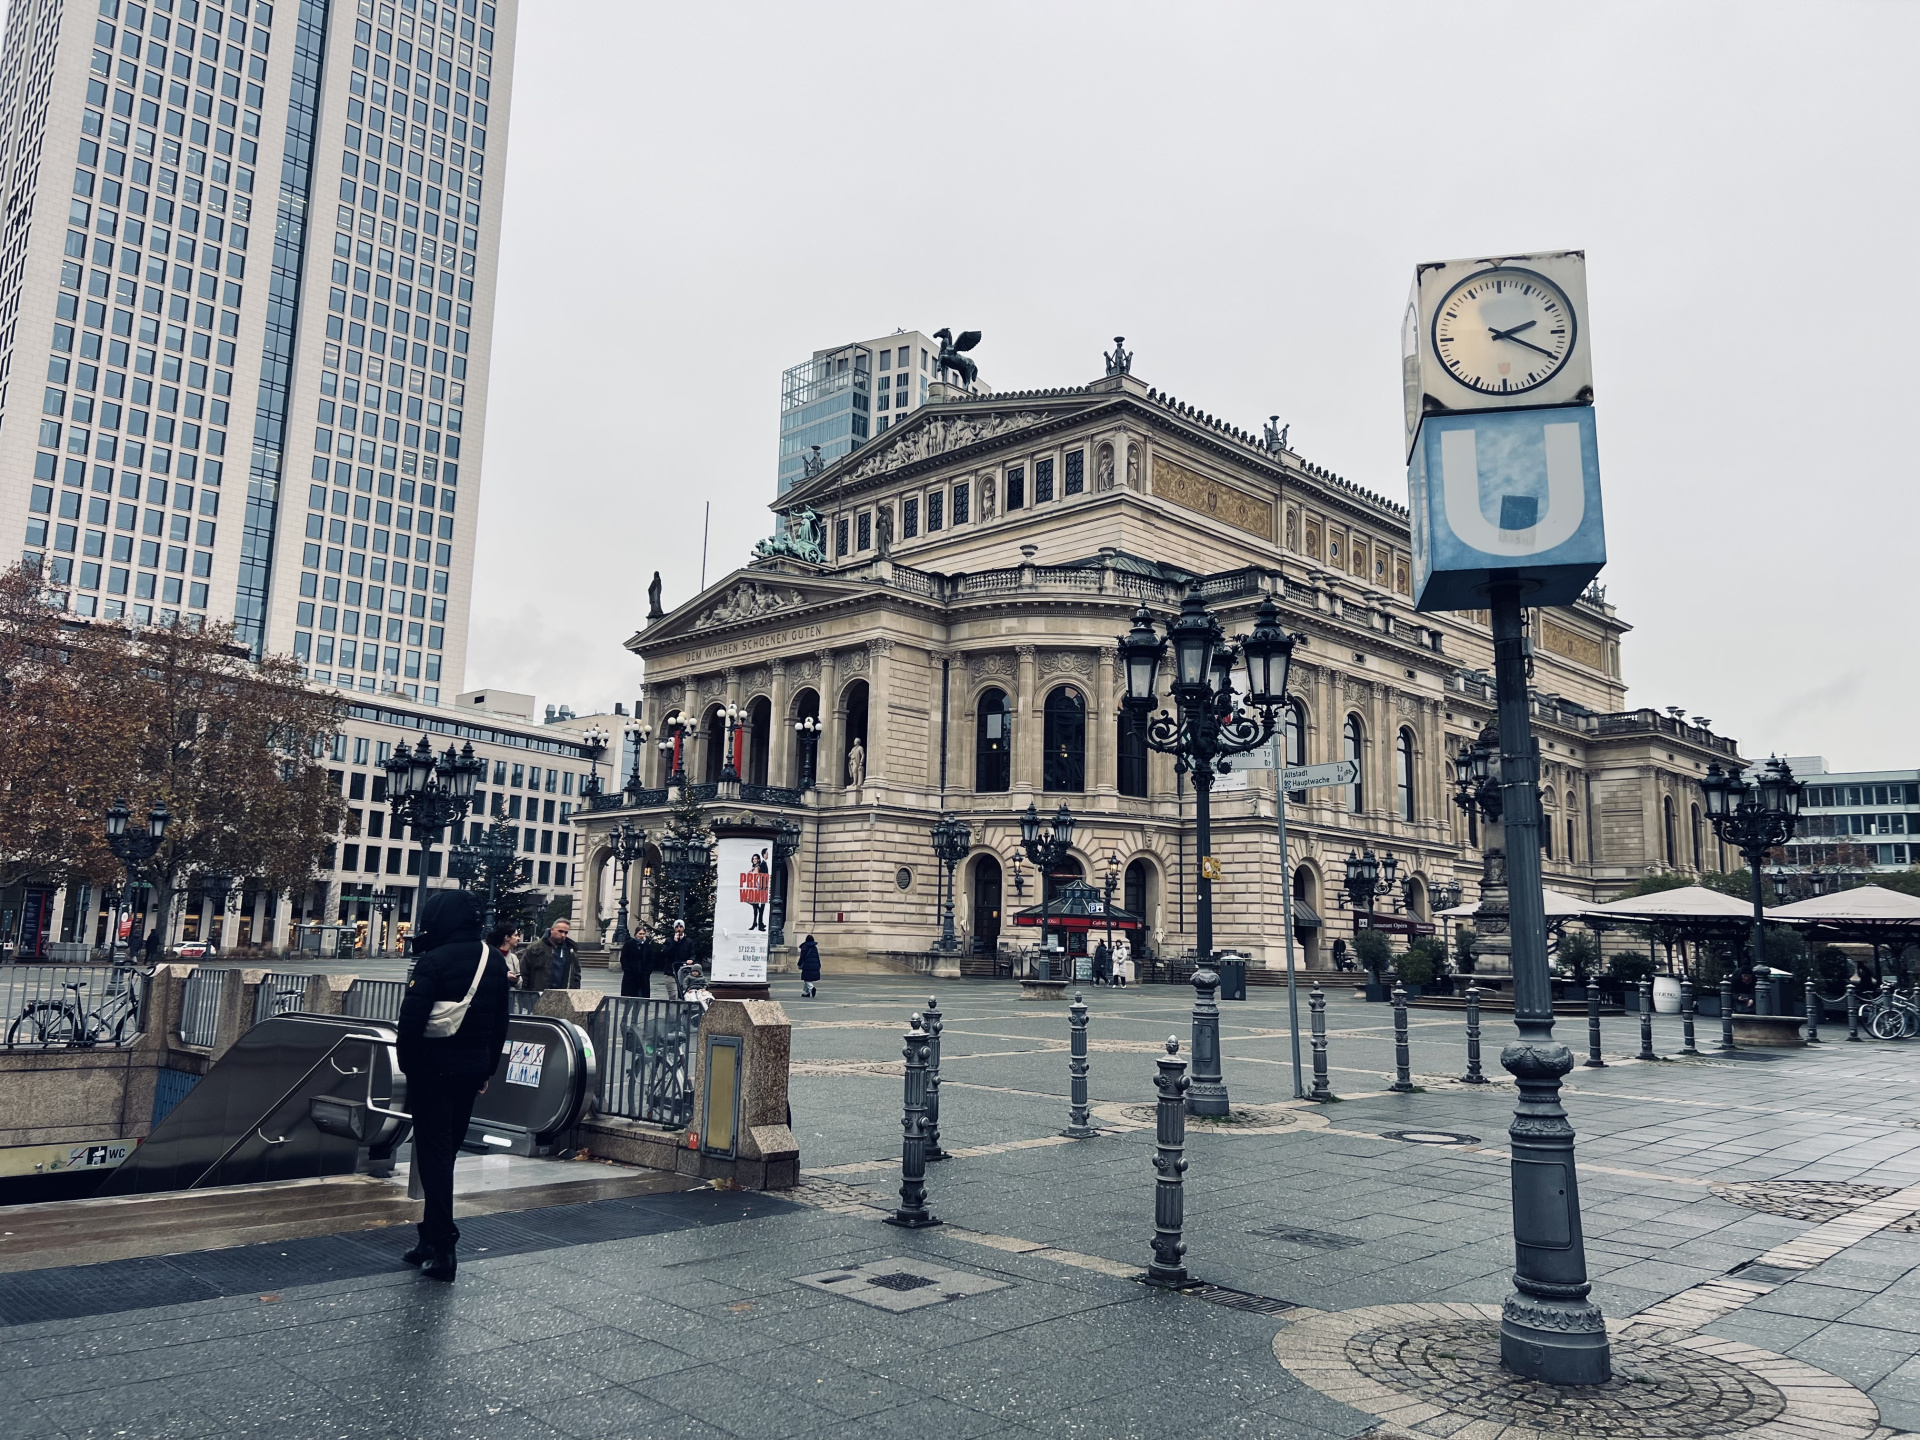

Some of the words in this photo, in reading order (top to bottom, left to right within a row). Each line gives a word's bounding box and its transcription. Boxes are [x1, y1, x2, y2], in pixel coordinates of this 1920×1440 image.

[1440, 422, 1585, 557] U
[686, 651, 702, 662] DEM
[704, 643, 738, 658] WAHREN
[742, 633, 787, 650] SCHOENEN
[1284, 770, 1308, 778] Altstadt
[1292, 777, 1330, 786] Hauptwache
[109, 1148, 125, 1159] WC
